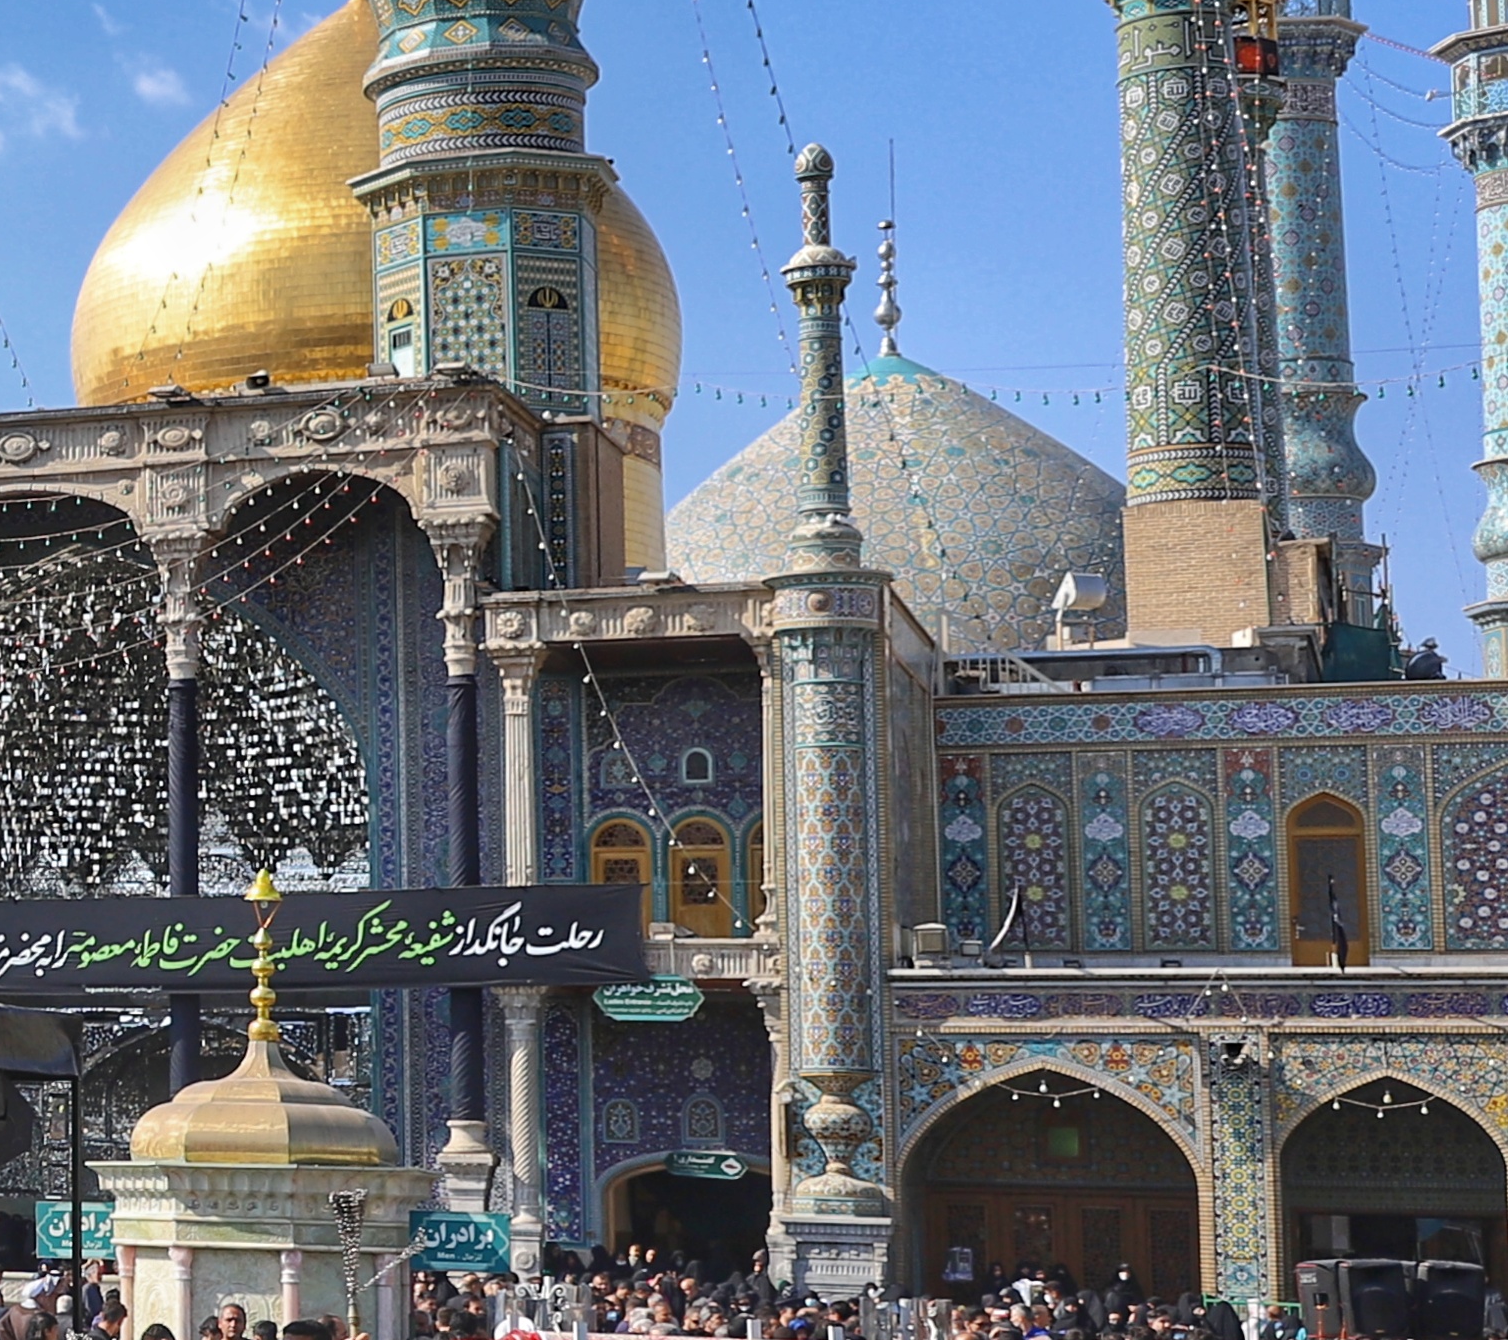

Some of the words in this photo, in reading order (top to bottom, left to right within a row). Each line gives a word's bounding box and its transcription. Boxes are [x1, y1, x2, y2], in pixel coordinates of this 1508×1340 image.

[51, 930, 70, 969] را
[159, 926, 241, 977] حضرت
[230, 920, 328, 971] اهلبت
[345, 917, 408, 972] محشر
[448, 901, 525, 967] جانگداز
[526, 921, 604, 956] رحلت
[35, 951, 53, 977] به
[603, 983, 645, 996] خواهران
[671, 983, 694, 996] محل
[49, 1212, 112, 1238] برادان
[424, 1222, 494, 1250] برادران
